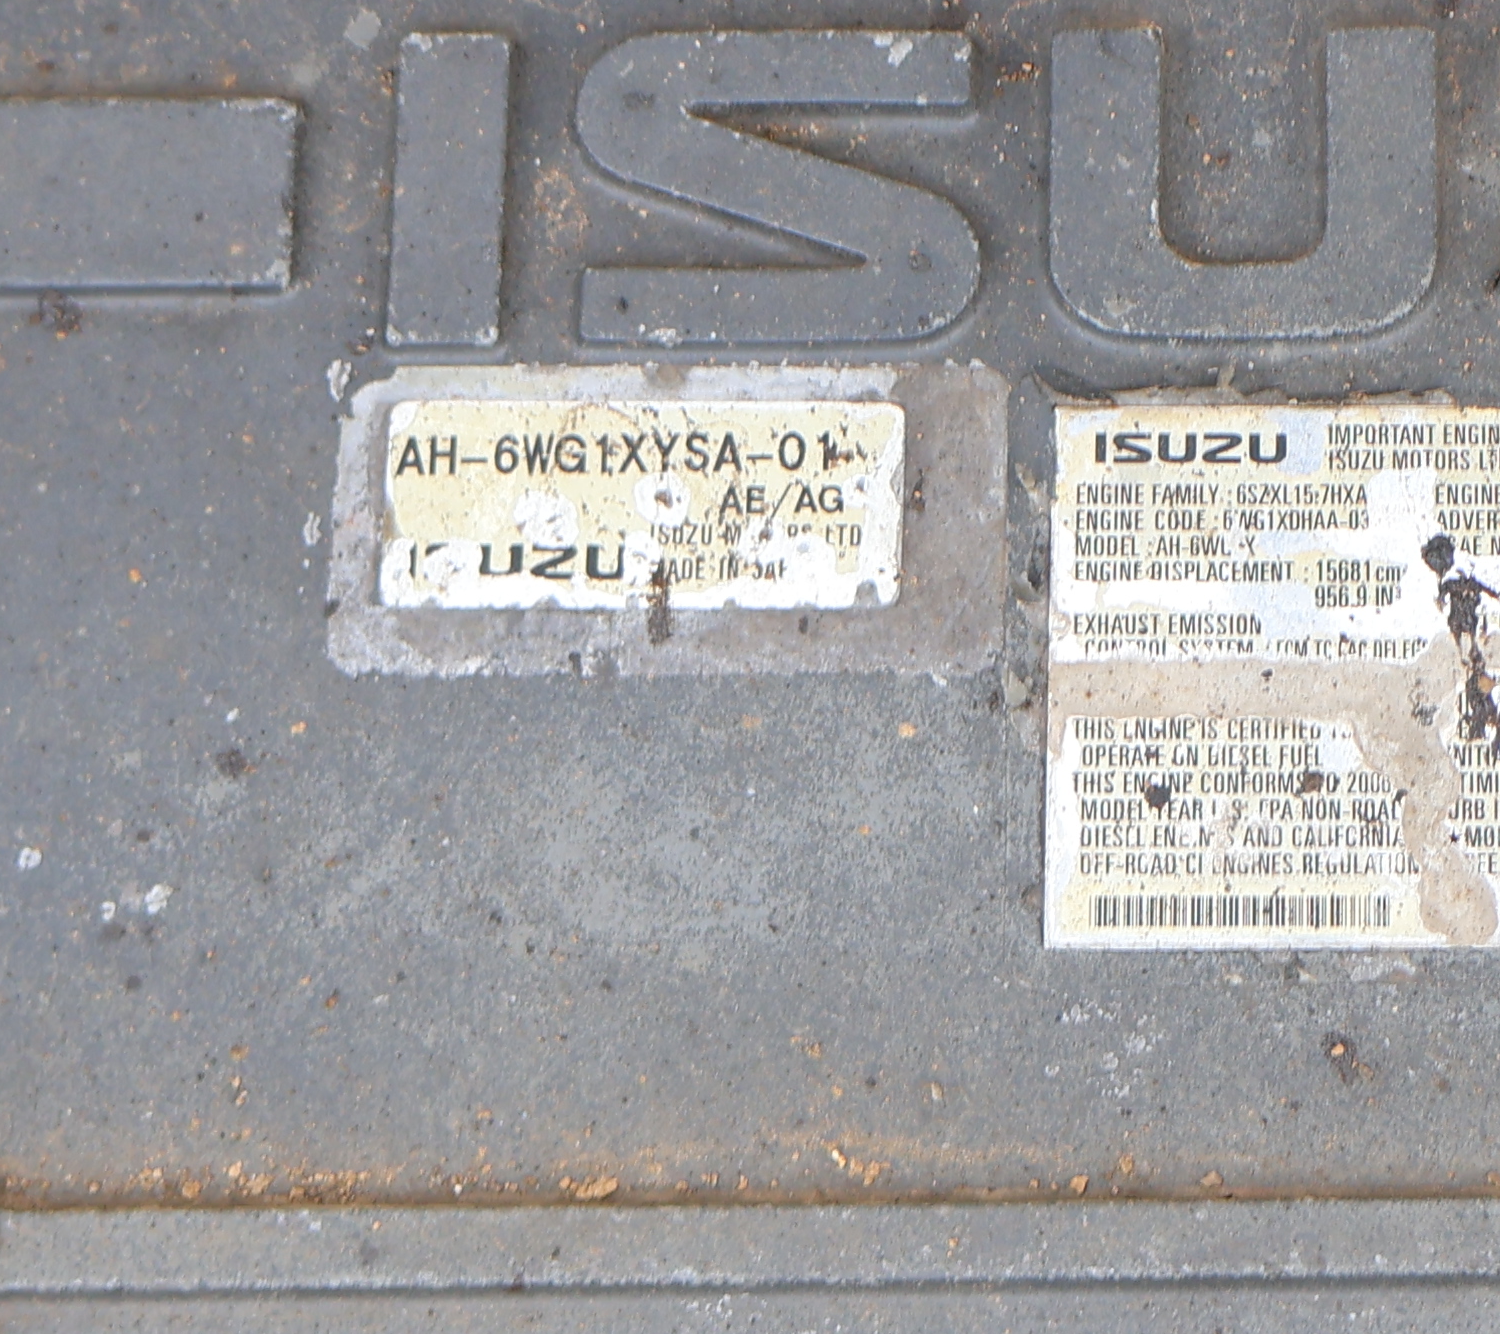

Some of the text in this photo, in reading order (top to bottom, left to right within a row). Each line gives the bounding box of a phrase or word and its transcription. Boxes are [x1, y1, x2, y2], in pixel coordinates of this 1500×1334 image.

[1328, 423, 1436, 445] IMPORTANT
[1095, 432, 1288, 464] ISUZU
[1329, 449, 1385, 471] ISUZU
[1393, 449, 1470, 471] MOTORS
[719, 479, 845, 520] AE/AG
[1076, 482, 1145, 505] ENGINE
[1152, 482, 1219, 505] FAMILY
[1076, 508, 1145, 531] ENGINE
[1155, 508, 1206, 531] CODE
[1075, 534, 1141, 557] MODEL
[409, 542, 625, 580] IUZU
[1074, 560, 1143, 583] ENGINE
[1151, 560, 1295, 583] DISPLACEMENT
[1315, 559, 1371, 583] 15681
[1314, 584, 1368, 607] 956.9
[1074, 612, 1262, 635] EXHAUST EMISSION
[1073, 717, 1115, 740] THIS
[1201, 717, 1218, 740] IS
[1279, 744, 1324, 767] FUEL
[1072, 771, 1115, 794] THIS
[1081, 798, 1147, 821] MODEL
[1243, 824, 1283, 847] AND
[1291, 824, 1405, 847] CALIFORNIA
